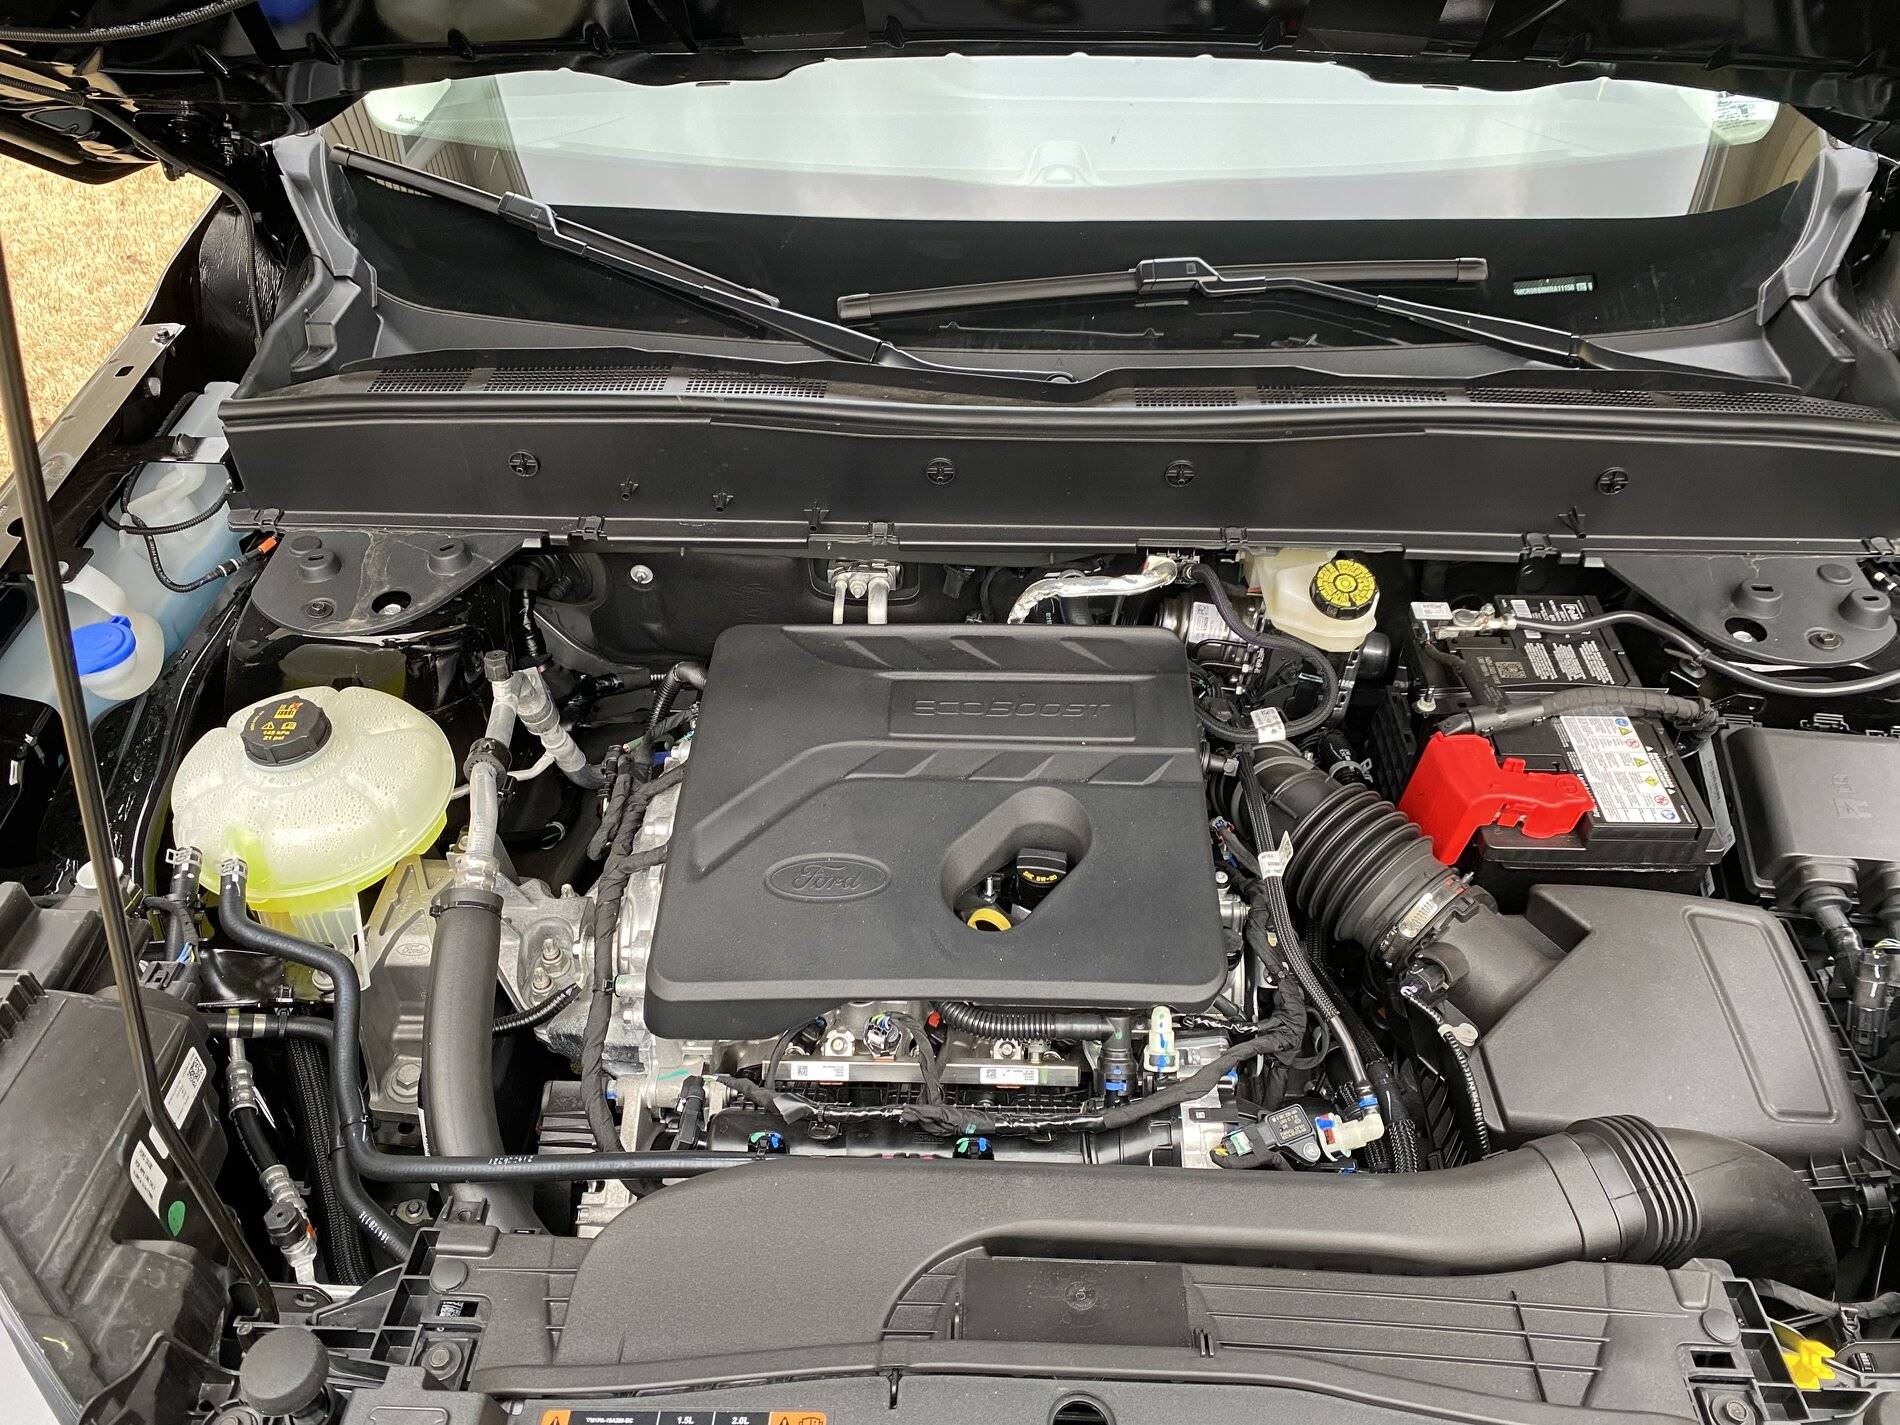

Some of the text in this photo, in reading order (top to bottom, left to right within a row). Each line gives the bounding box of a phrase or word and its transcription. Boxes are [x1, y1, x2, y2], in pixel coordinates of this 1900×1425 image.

[792, 864, 863, 890] Ford
[677, 1416, 694, 1425] 1.5L
[732, 1416, 749, 1425] 2.0L
